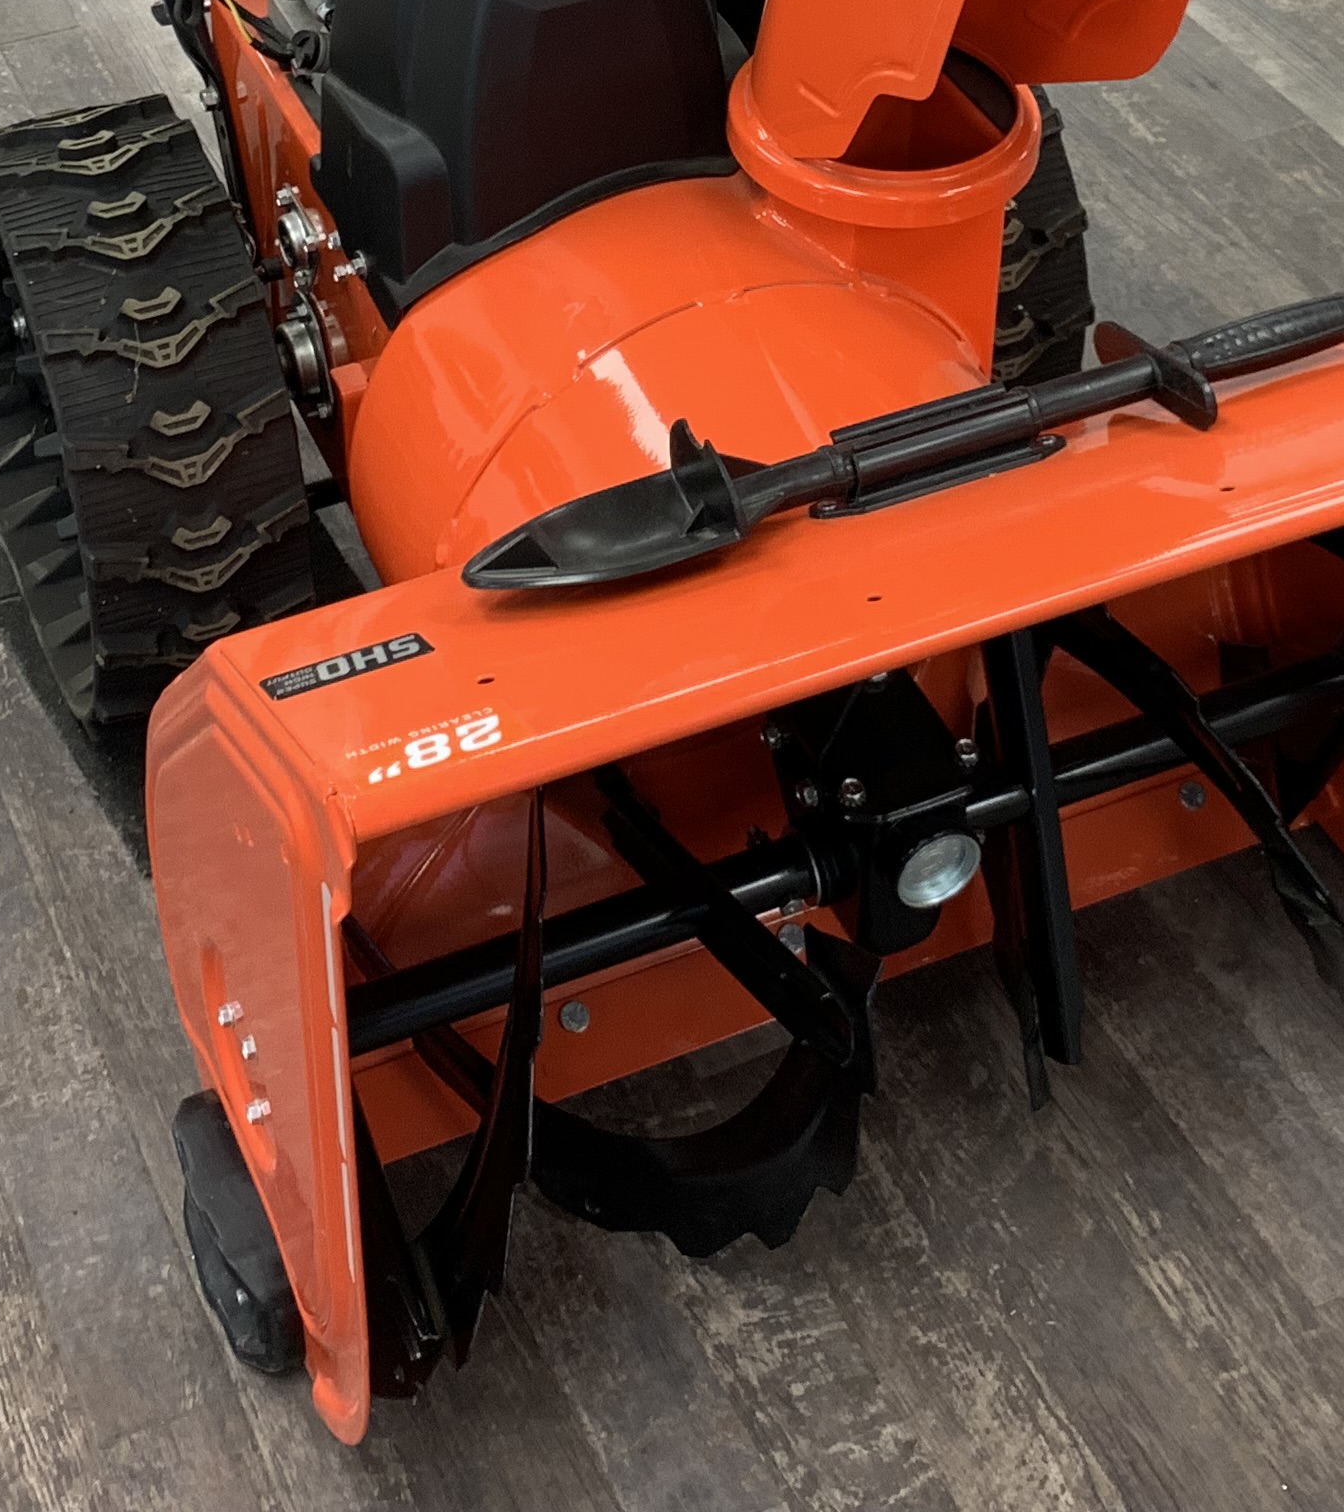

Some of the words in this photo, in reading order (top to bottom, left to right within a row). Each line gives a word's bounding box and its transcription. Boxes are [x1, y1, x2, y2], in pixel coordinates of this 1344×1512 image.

[315, 634, 421, 681] SHO
[407, 706, 494, 738] CLEARING
[344, 736, 403, 760] WIDTH
